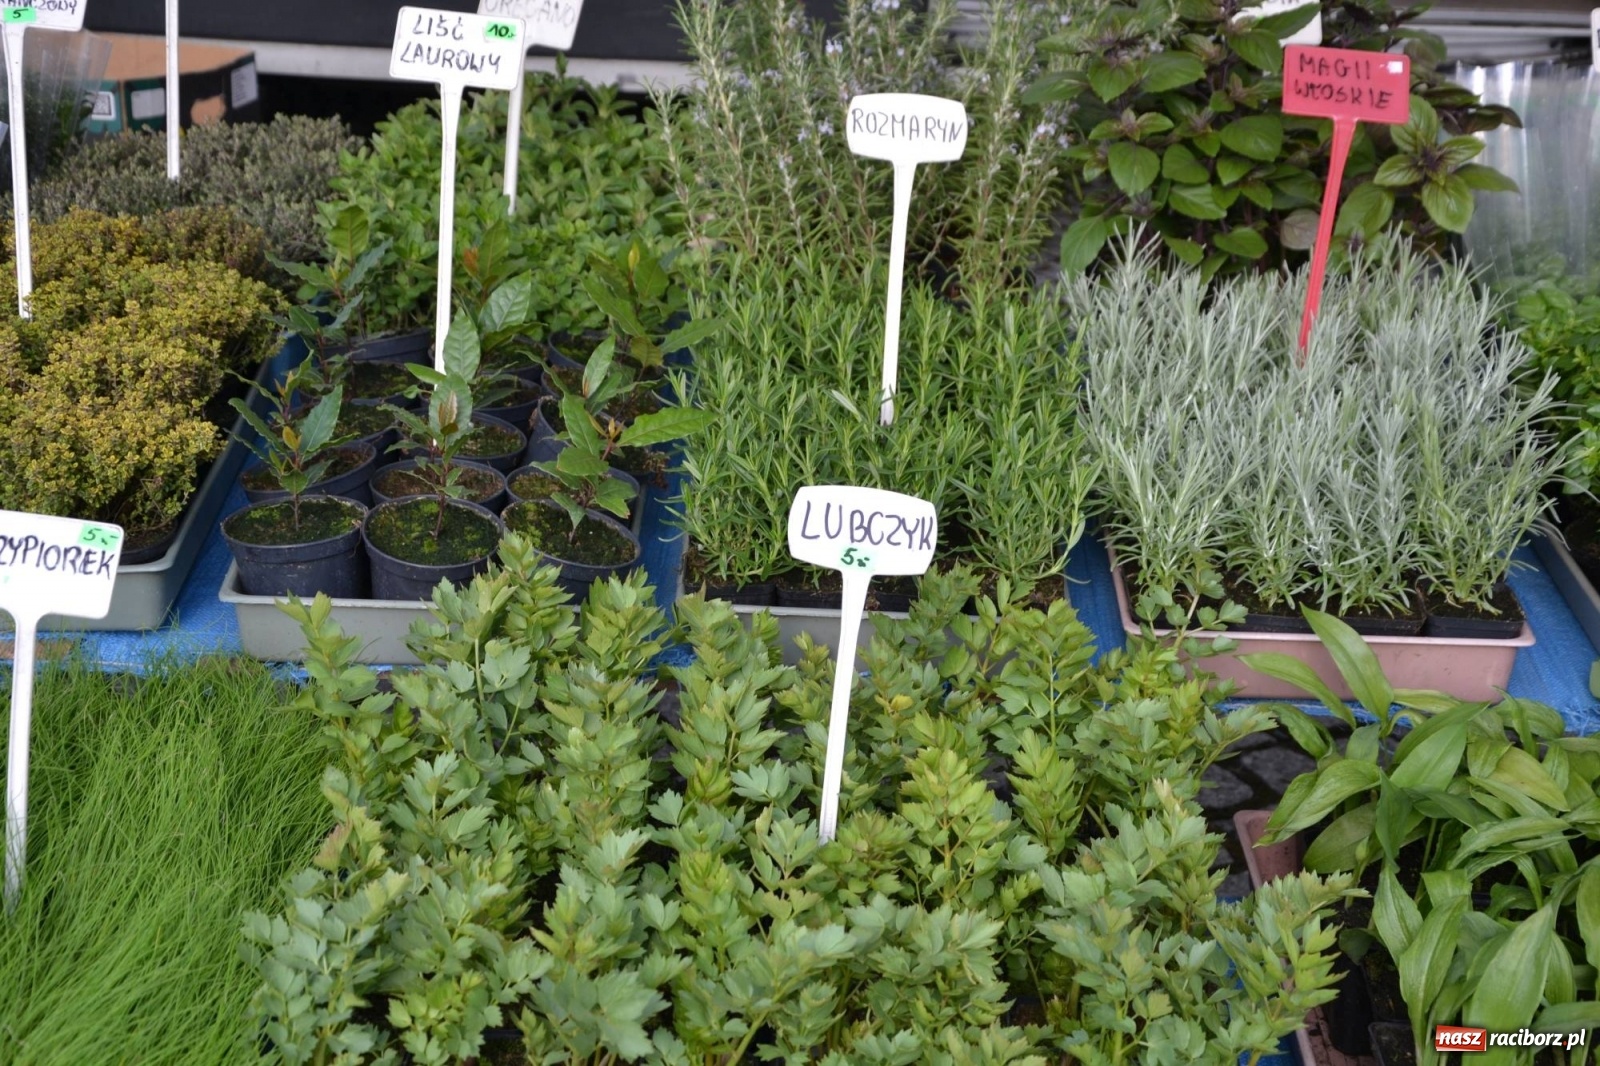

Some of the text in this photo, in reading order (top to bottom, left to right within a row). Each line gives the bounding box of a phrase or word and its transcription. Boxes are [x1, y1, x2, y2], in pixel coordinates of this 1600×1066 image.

[400, 41, 502, 75] LAUROWY
[1299, 52, 1371, 80] MAGII
[851, 107, 964, 143] ROZMARYN
[800, 500, 934, 551] LUBCZYK
